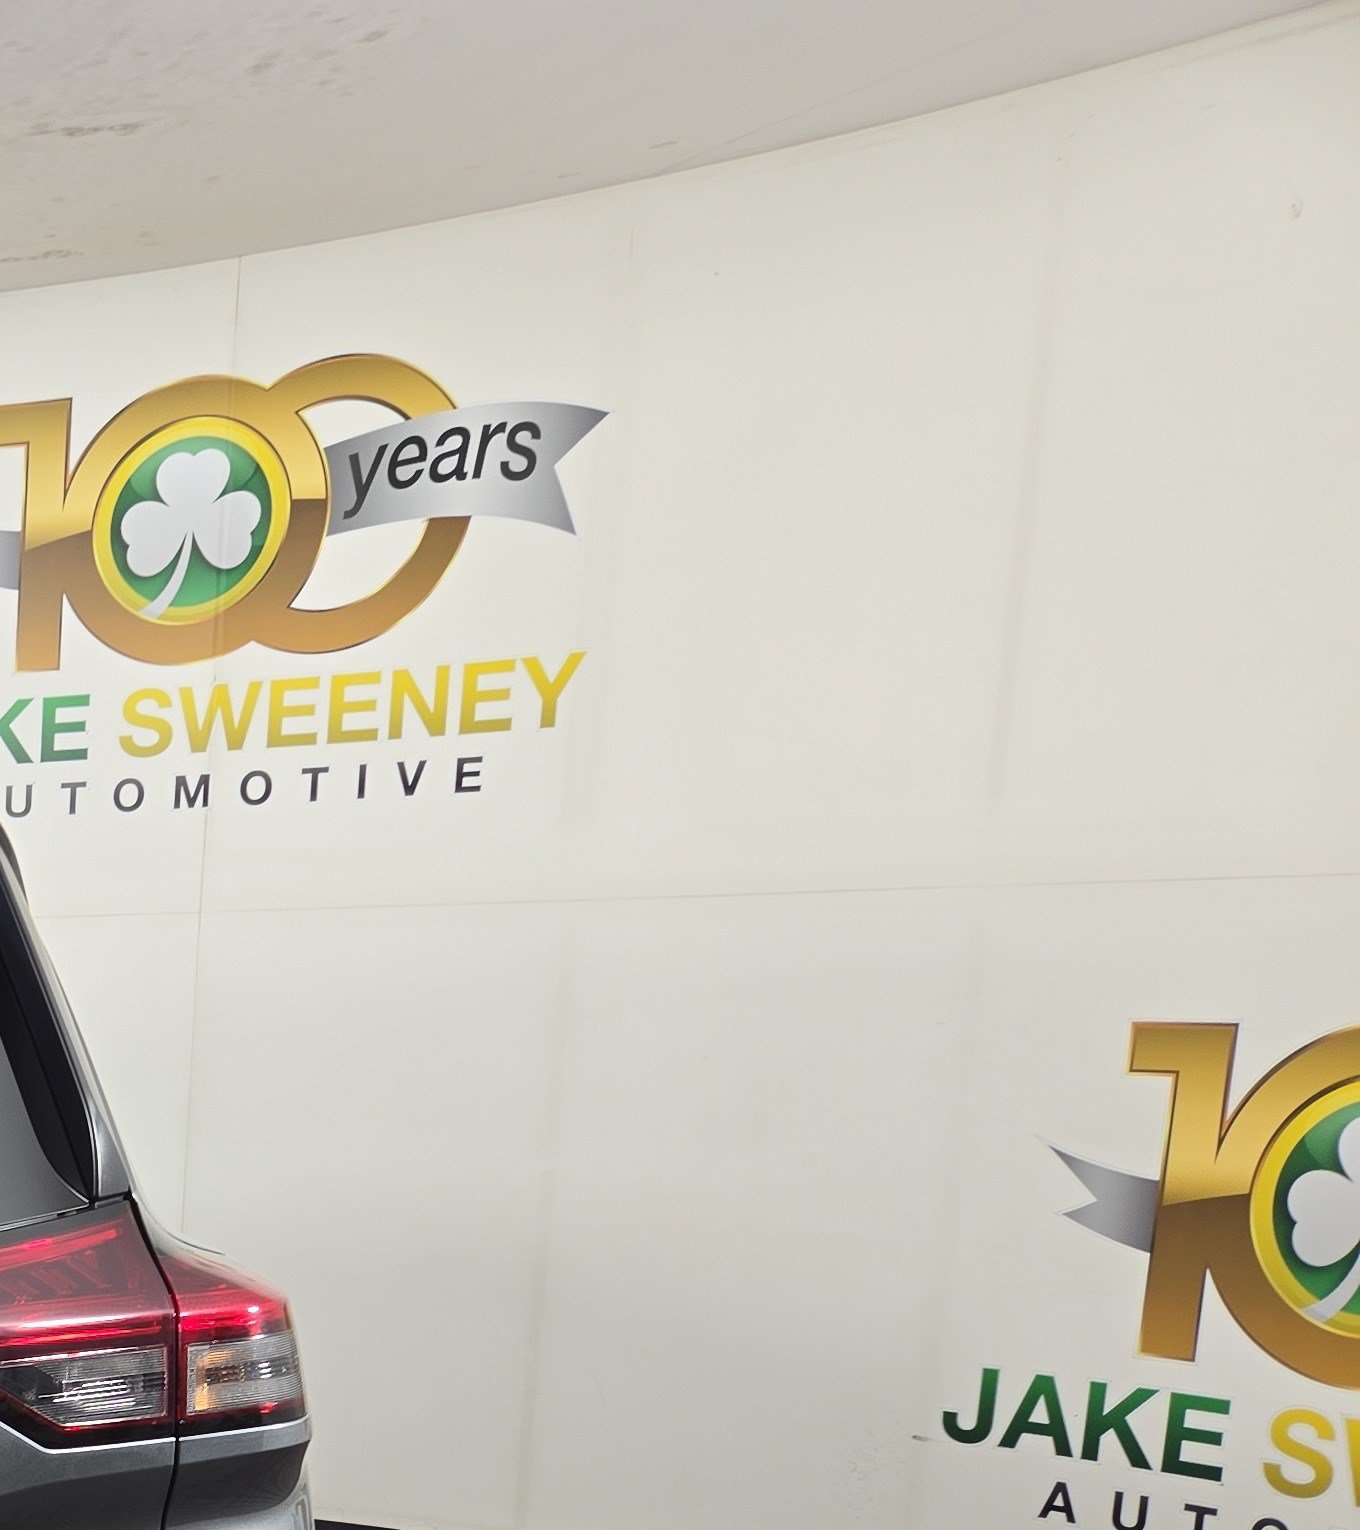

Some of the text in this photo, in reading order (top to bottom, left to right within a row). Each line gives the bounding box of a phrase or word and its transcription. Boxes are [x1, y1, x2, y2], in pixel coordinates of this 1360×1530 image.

[342, 418, 542, 519] years
[118, 651, 588, 759] SWEENEY
[4, 755, 484, 819] UTOMOTIVE
[942, 1367, 1232, 1483] JAKE
